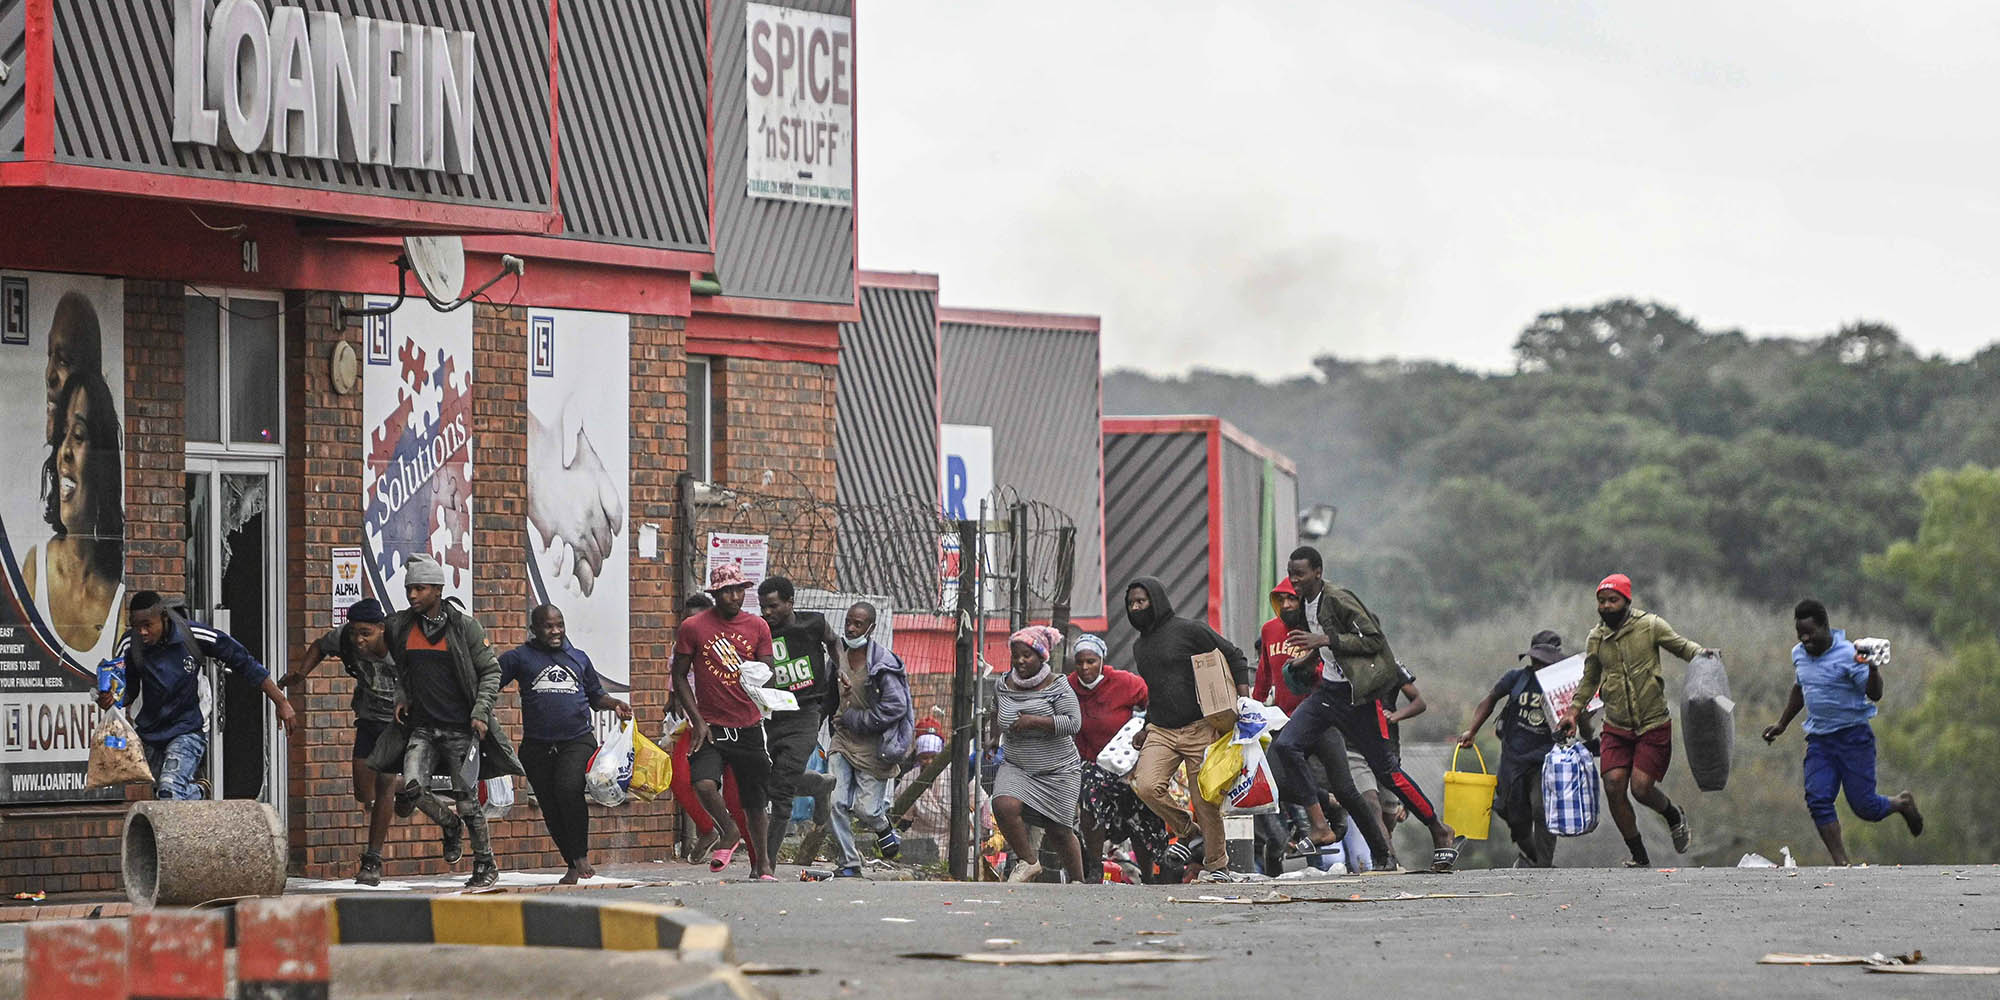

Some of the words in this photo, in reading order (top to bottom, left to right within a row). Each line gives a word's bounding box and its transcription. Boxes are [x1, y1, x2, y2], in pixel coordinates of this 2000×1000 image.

[752, 19, 849, 105] SPICE
[172, 0, 475, 175] LOANFIN
[241, 241, 259, 273] 9A
[376, 412, 467, 525] Solutions
[334, 584, 360, 596] ALPHA
[0, 628, 14, 638] EASY
[0, 644, 25, 654] PAYMENT
[0, 661, 18, 670] TERMS
[19, 661, 26, 670] TO
[27, 661, 40, 670] SUIT
[774, 659, 811, 685] BIG
[16, 678, 44, 687] FINANCIAL
